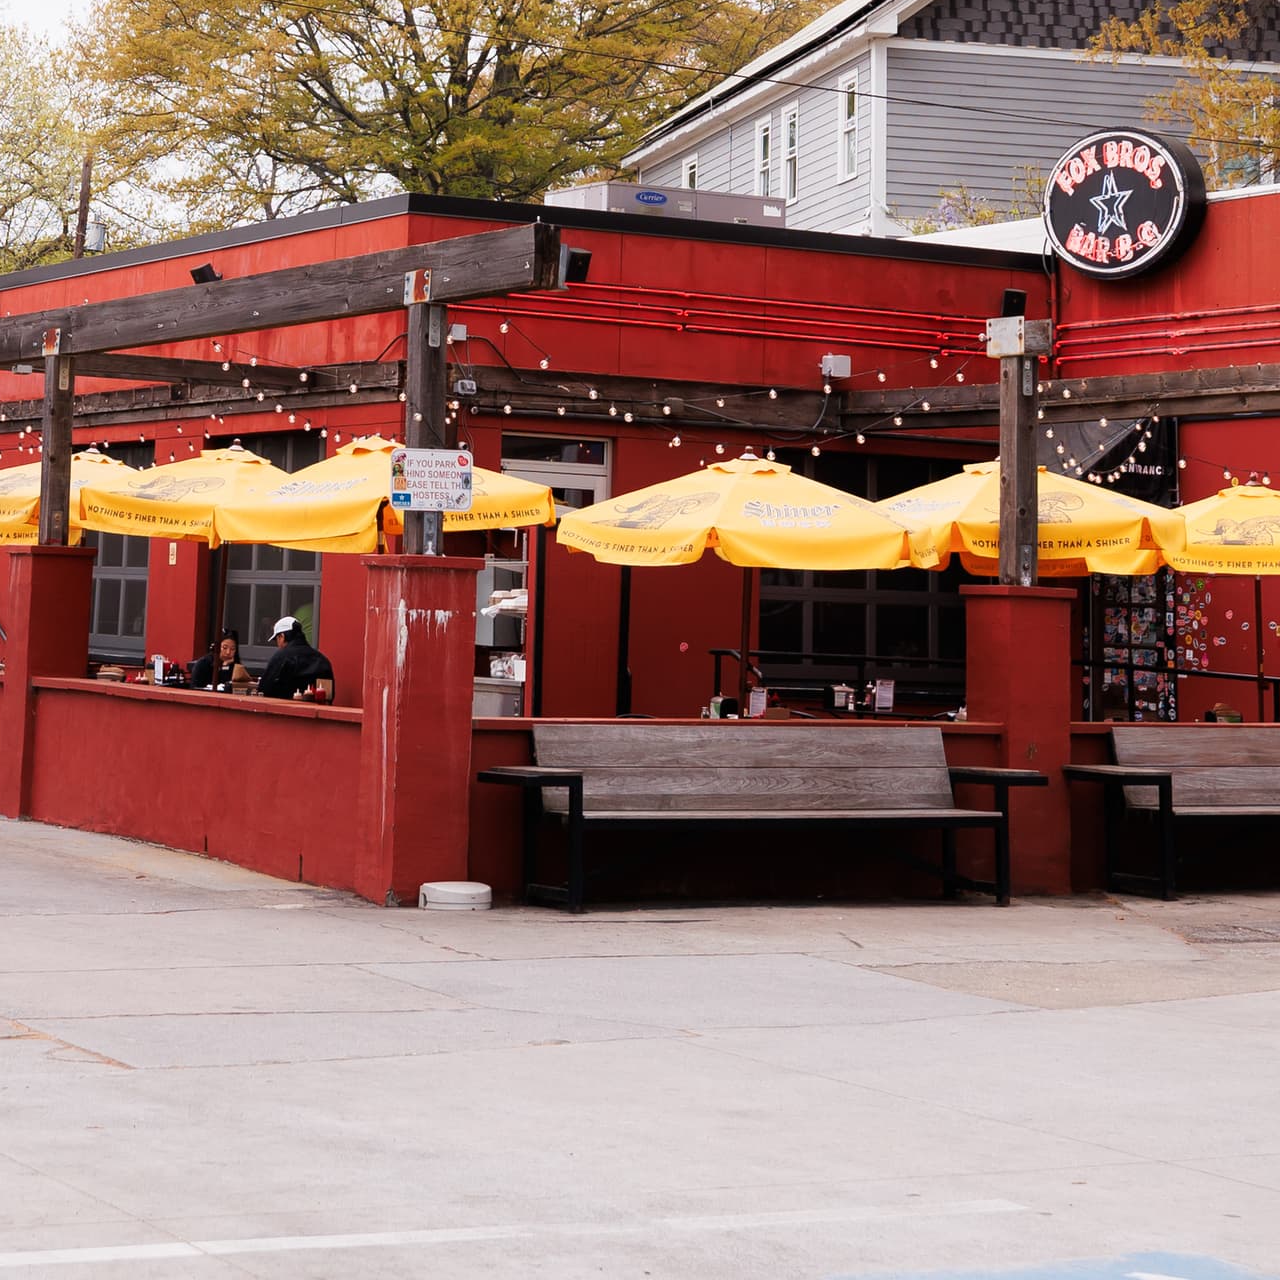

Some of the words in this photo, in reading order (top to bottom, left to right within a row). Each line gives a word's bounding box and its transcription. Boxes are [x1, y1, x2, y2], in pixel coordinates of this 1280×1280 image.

[1056, 146, 1101, 196] FOX
[1102, 140, 1166, 189] BROS.
[1065, 220, 1162, 264] BAR-B-Q
[406, 459, 415, 467] IF
[416, 460, 433, 468] YOU
[434, 460, 456, 468] PARK
[1122, 463, 1164, 475] NTRANC
[406, 469, 426, 478] HIND
[427, 470, 464, 479] SOMEON
[406, 480, 428, 489] EASE
[430, 481, 448, 489] TELL
[451, 482, 461, 490] TH
[87, 504, 132, 520] NOTHING'S
[134, 513, 157, 523] FINER
[159, 516, 180, 526] THAN
[450, 513, 474, 522] FINER
[477, 511, 500, 521] THAN
[503, 511, 509, 519] A
[511, 509, 541, 519] SHINER
[562, 530, 610, 550] NOTHING'S
[612, 544, 636, 553] FINER
[637, 545, 659, 553] THAN
[661, 546, 666, 554] A
[972, 539, 1000, 549] NOTHI
[1037, 540, 1054, 549] NER
[1058, 540, 1082, 549] THAN
[1086, 540, 1092, 548] A
[1095, 537, 1131, 547] SHINER
[1172, 557, 1224, 568] NOTHING'S
[1226, 560, 1253, 568] FINER
[1257, 560, 1280, 568] THAN
